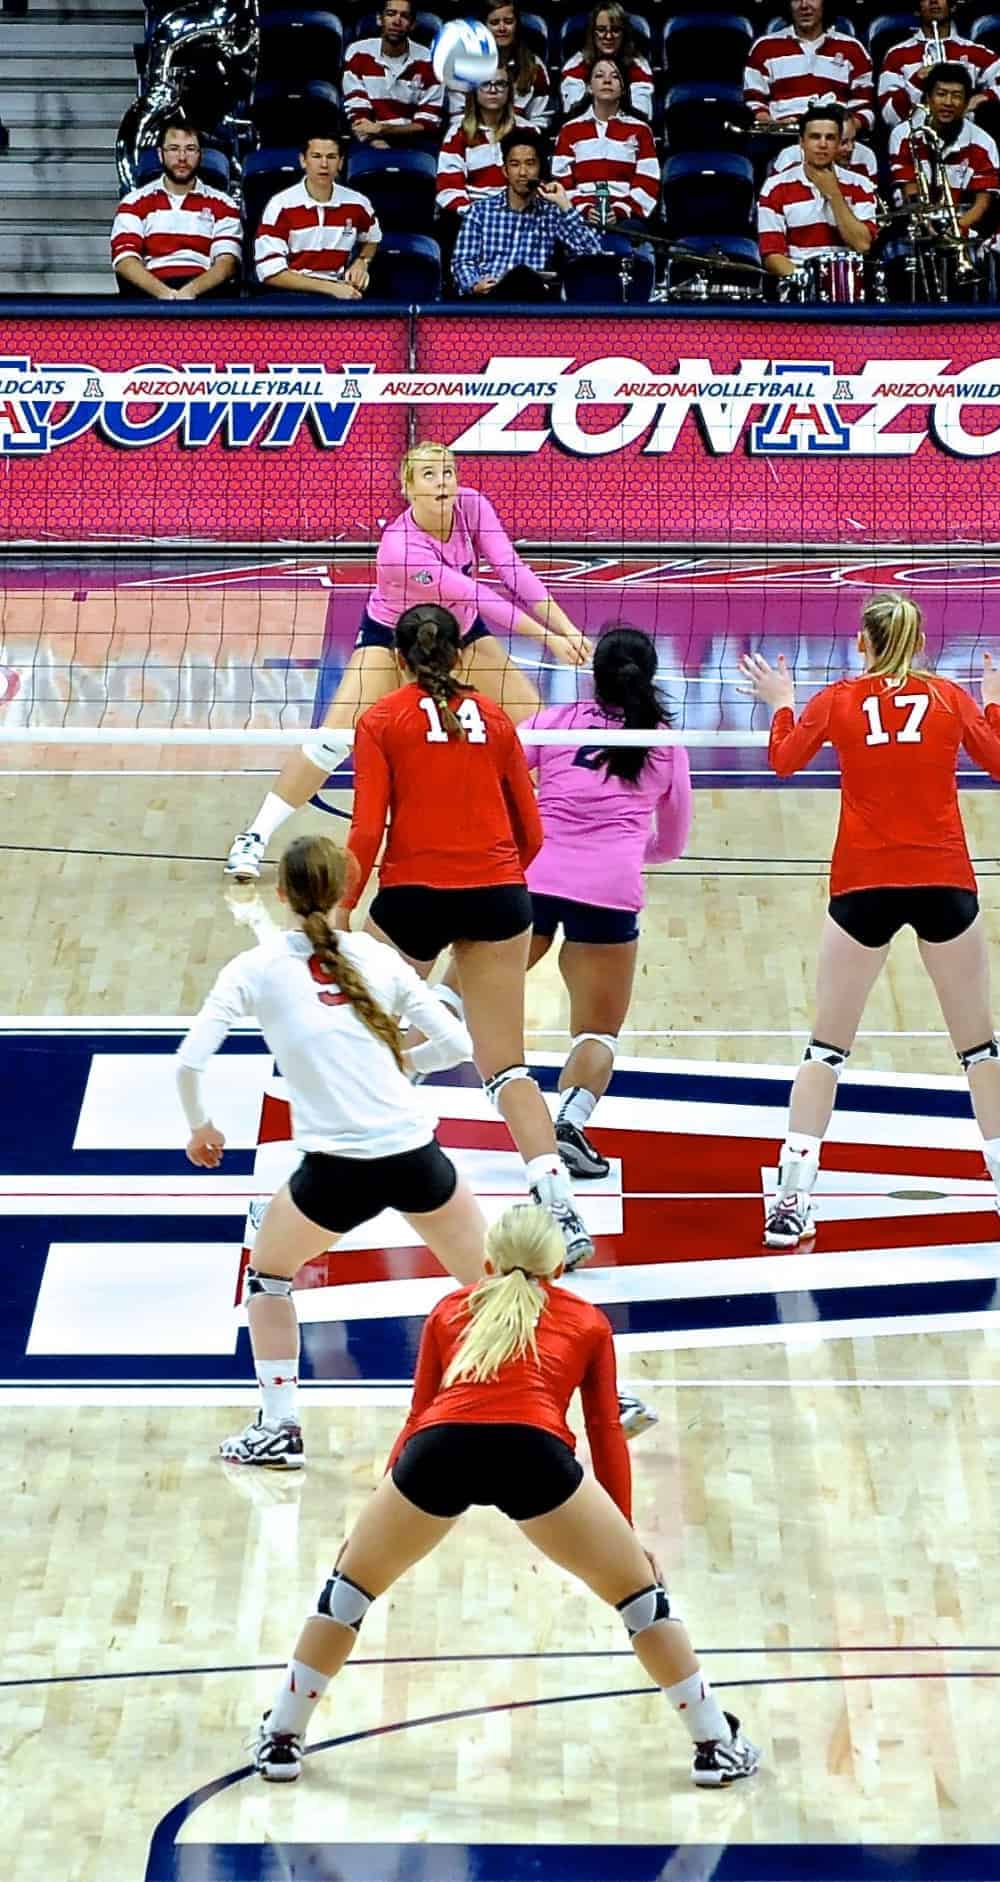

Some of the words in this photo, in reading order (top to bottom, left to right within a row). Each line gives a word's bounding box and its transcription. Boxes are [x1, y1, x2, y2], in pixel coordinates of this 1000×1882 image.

[123, 381, 323, 395] ARIZONAVOLLEYBALL
[381, 381, 557, 396] ARIZONAWILDCATS
[614, 382, 815, 397] ARIZONAVOLLEYBALL
[419, 697, 487, 744] 14
[862, 694, 929, 745] 17
